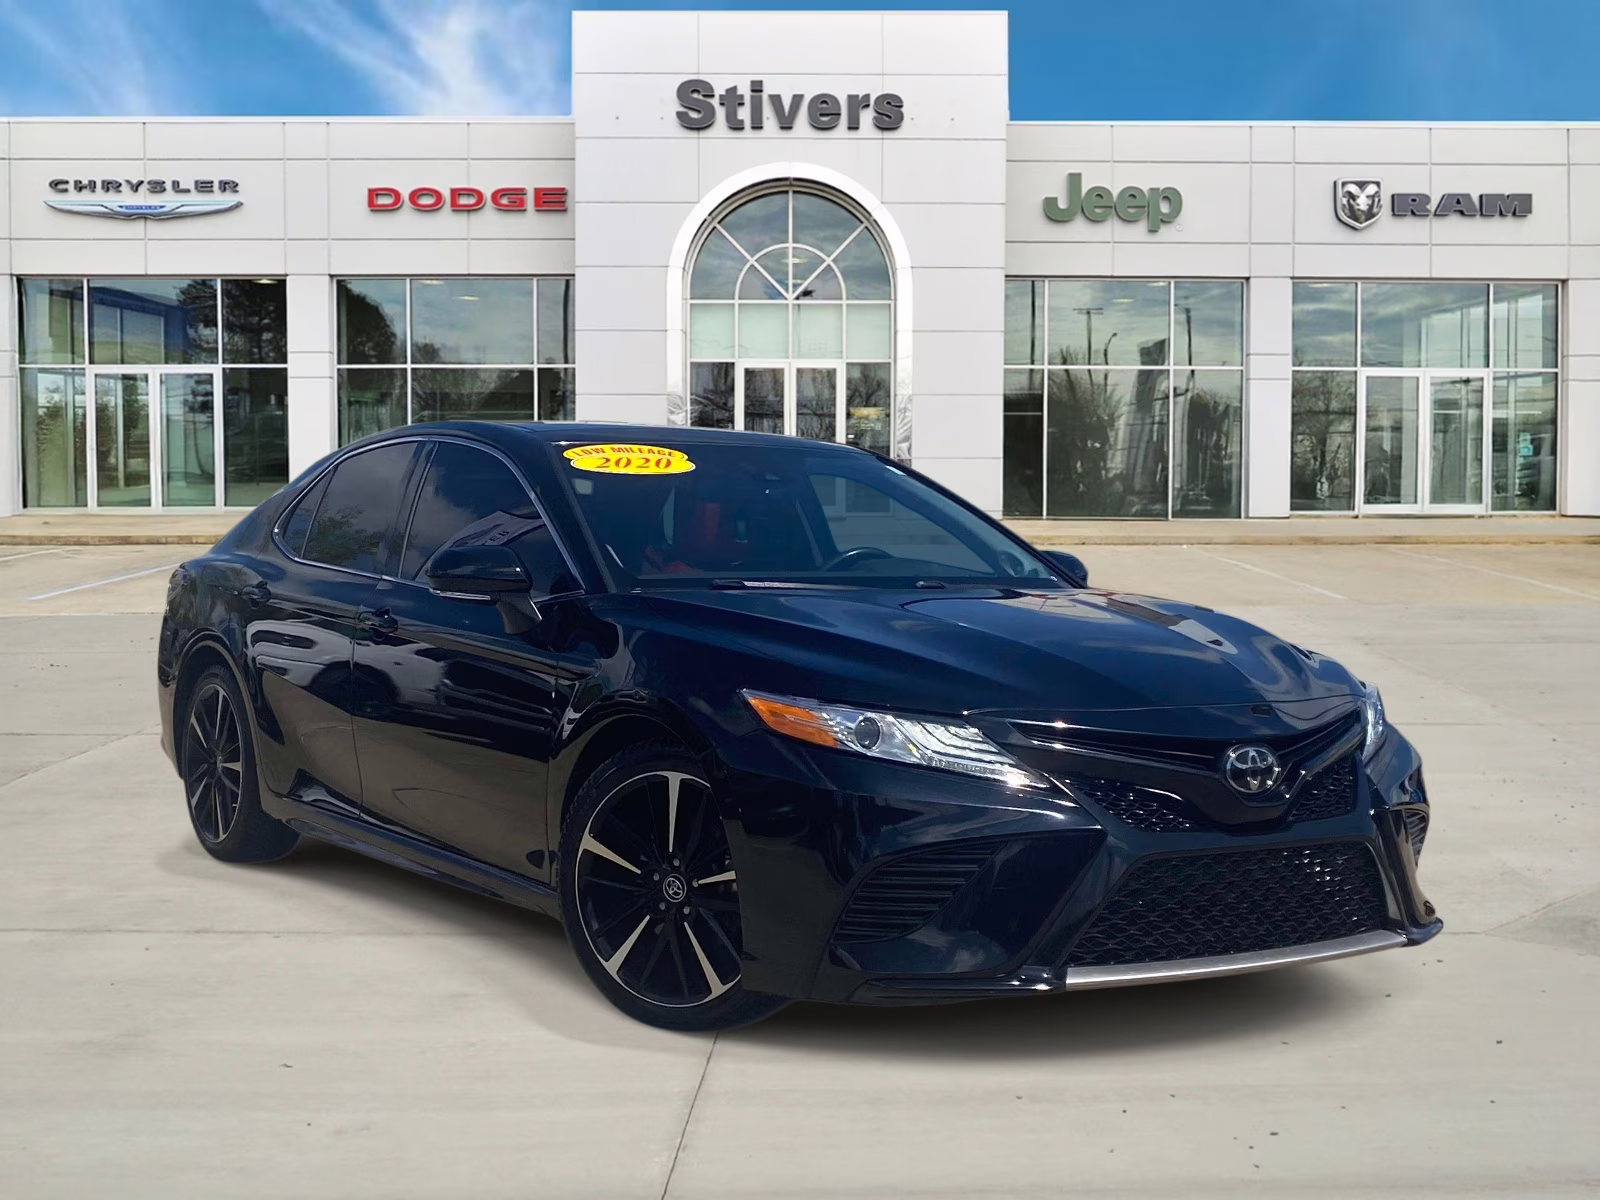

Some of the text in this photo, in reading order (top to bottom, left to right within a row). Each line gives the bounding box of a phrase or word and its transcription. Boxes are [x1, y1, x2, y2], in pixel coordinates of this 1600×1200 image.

[676, 79, 905, 131] Stivers
[49, 178, 240, 194] CHRYSLER
[367, 187, 568, 212] DODGE
[1043, 172, 1182, 232] Jeep
[1391, 193, 1533, 216] RAM
[572, 446, 677, 458] LOW MILEAGE
[595, 457, 672, 469] 2020
